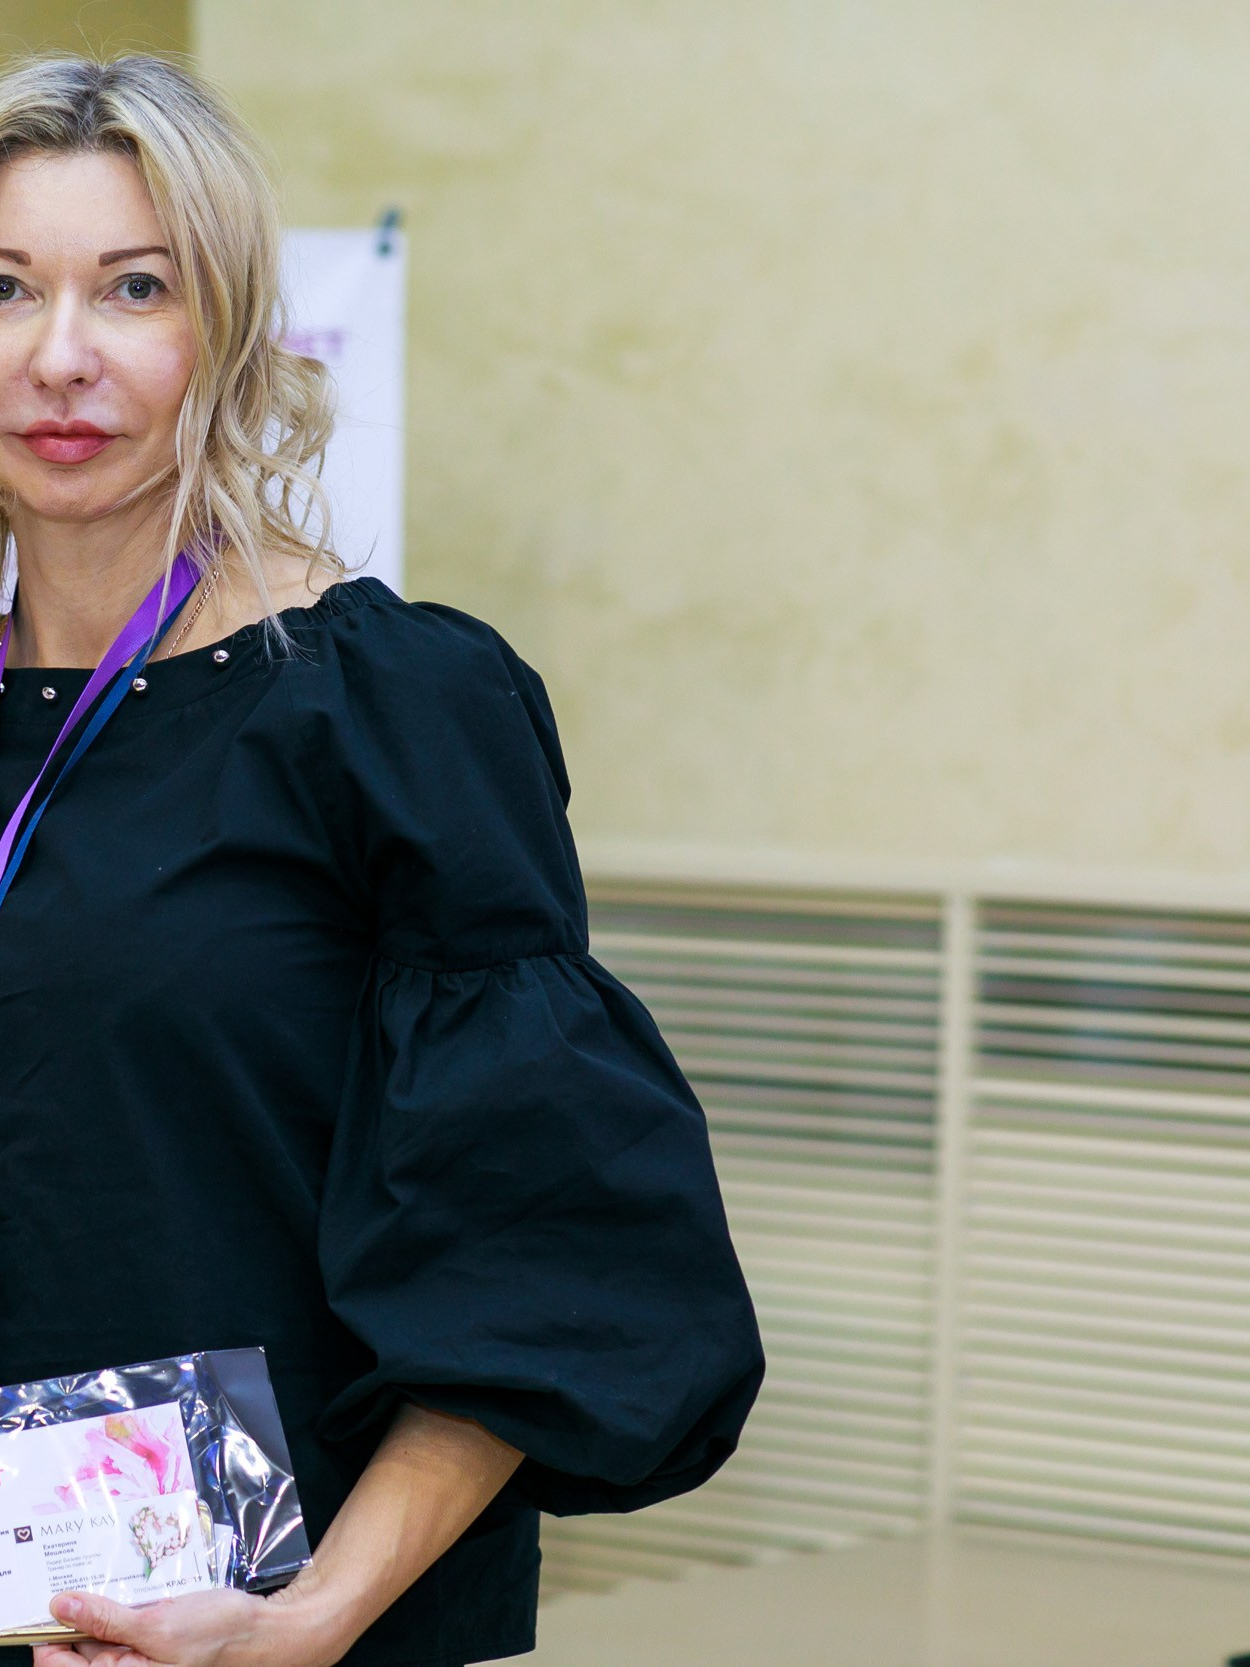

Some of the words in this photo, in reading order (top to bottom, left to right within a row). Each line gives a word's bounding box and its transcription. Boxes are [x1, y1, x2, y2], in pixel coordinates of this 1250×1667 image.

[40, 1517, 84, 1538] MARY
[90, 1513, 118, 1526] KAY
[42, 1540, 78, 1551] Екатерина
[44, 1548, 75, 1557] Мешкова
